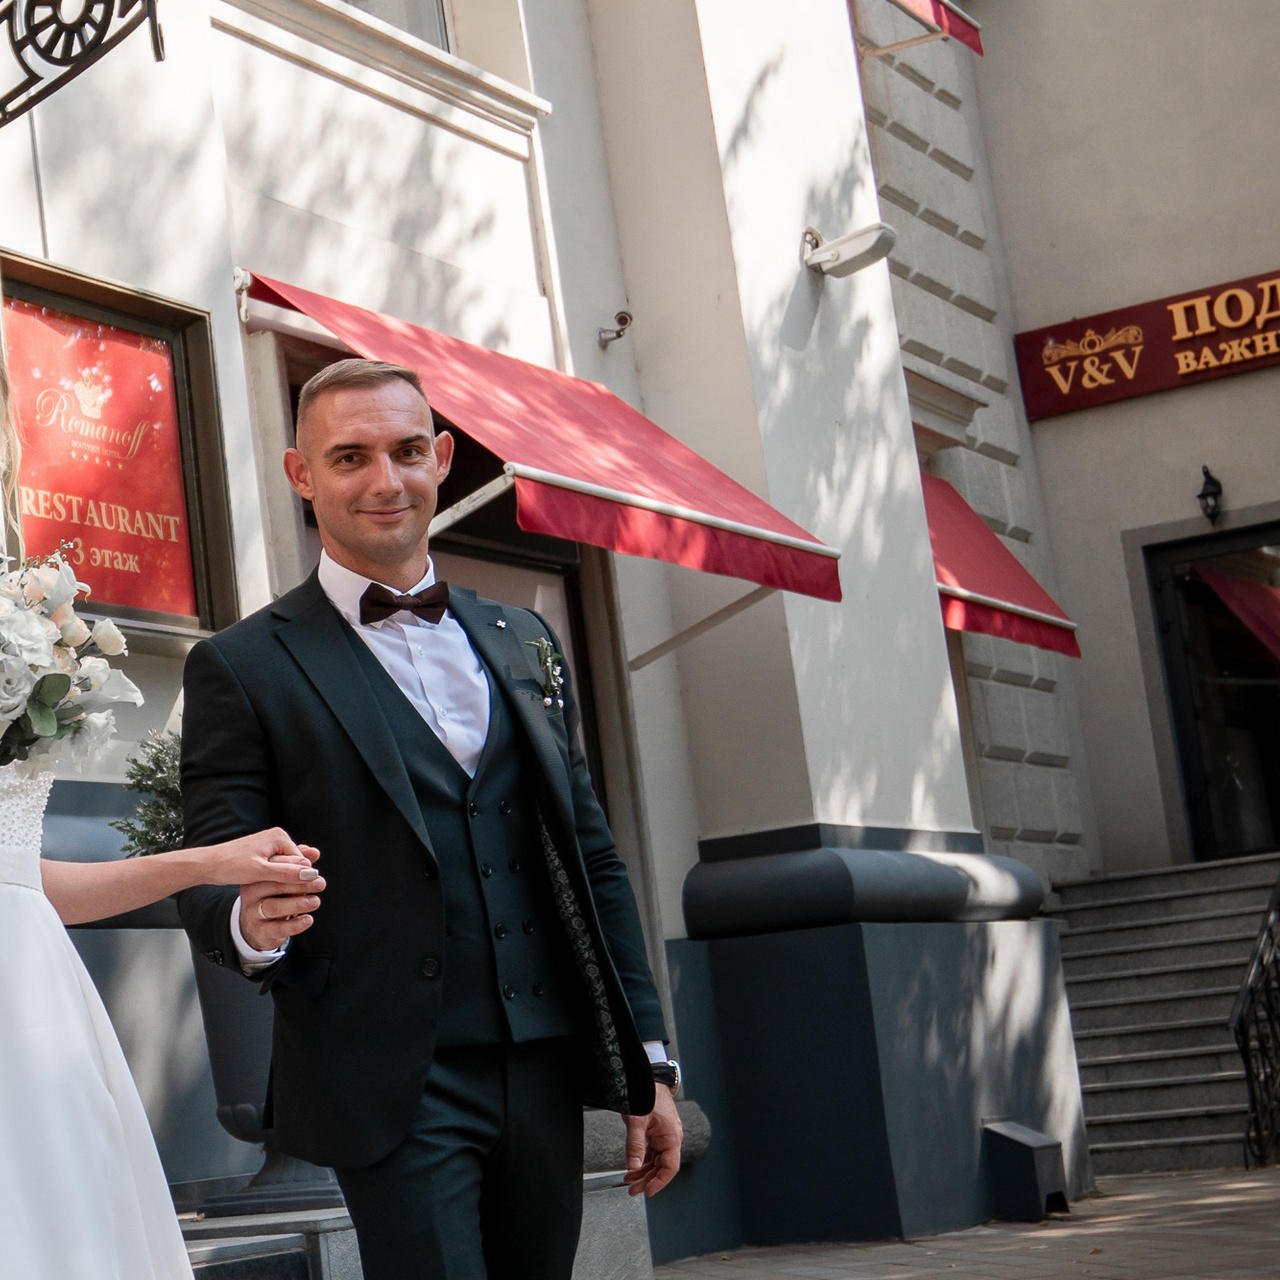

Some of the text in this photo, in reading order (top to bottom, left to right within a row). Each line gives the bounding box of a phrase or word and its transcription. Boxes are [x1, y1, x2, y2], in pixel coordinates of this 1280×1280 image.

[1045, 345, 1144, 395] V&V
[1174, 329, 1280, 375] ВАЖН
[35, 388, 150, 460] Romanoff
[20, 487, 180, 543] RESTAURANT
[72, 537, 141, 574] 3 этаж
